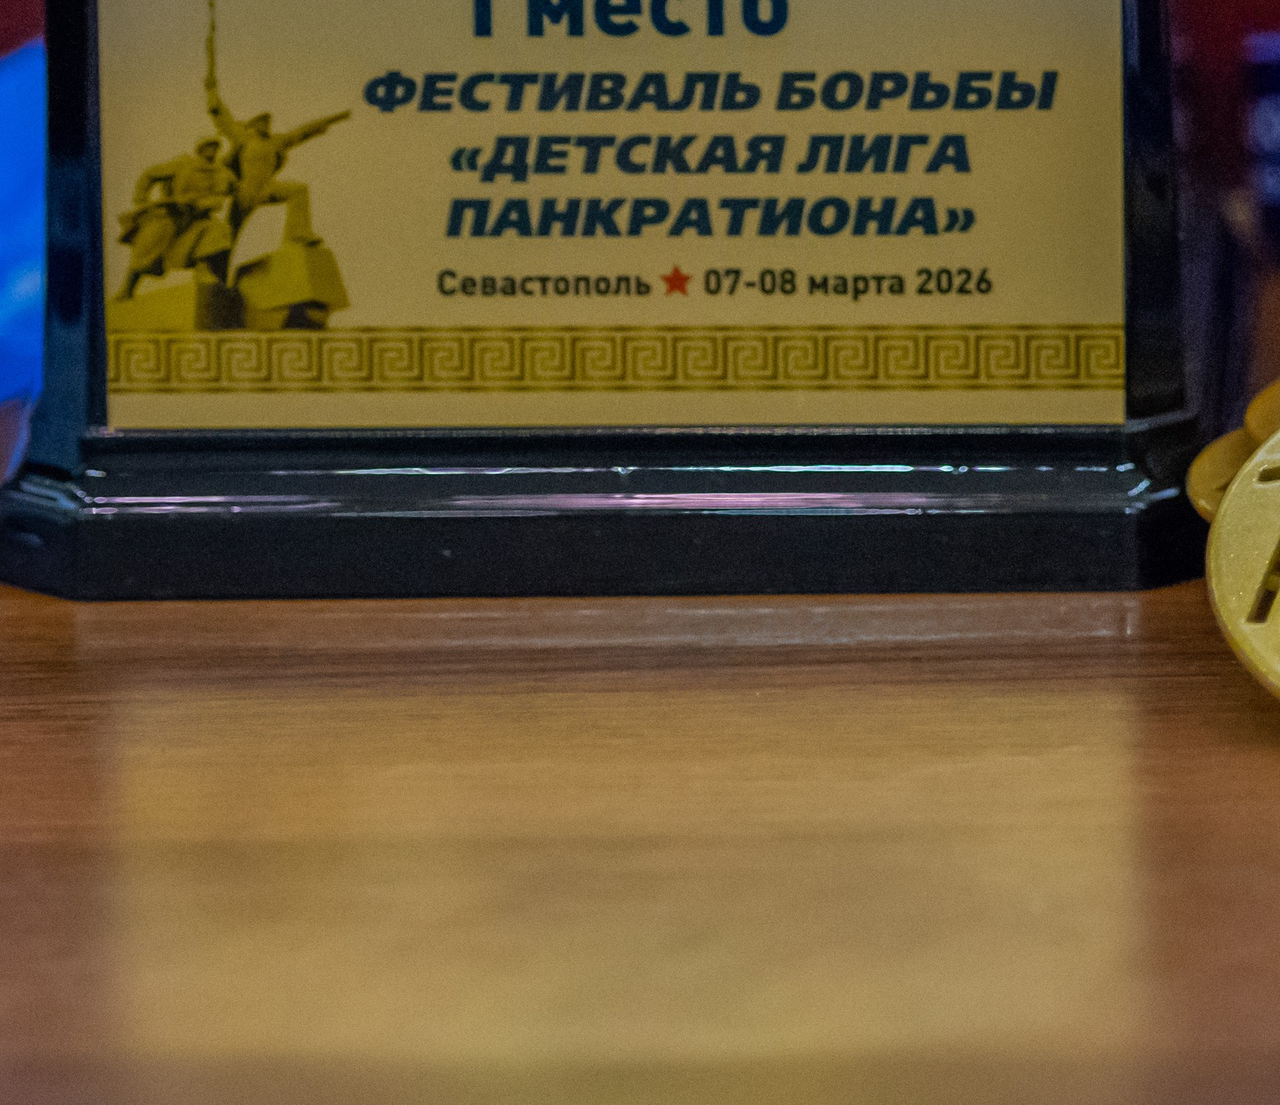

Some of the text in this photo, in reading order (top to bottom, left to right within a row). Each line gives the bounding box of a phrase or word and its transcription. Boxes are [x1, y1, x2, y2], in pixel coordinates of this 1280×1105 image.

[363, 69, 1060, 113] ФЕСТИВАЛЬ БОРЬБЫ
[449, 134, 971, 183] «ДЕТСКАЯ ЛИГА
[445, 197, 975, 238] ПАНКРАТИОНА»
[437, 268, 993, 302] Севастополь 07-08 марта 2026
